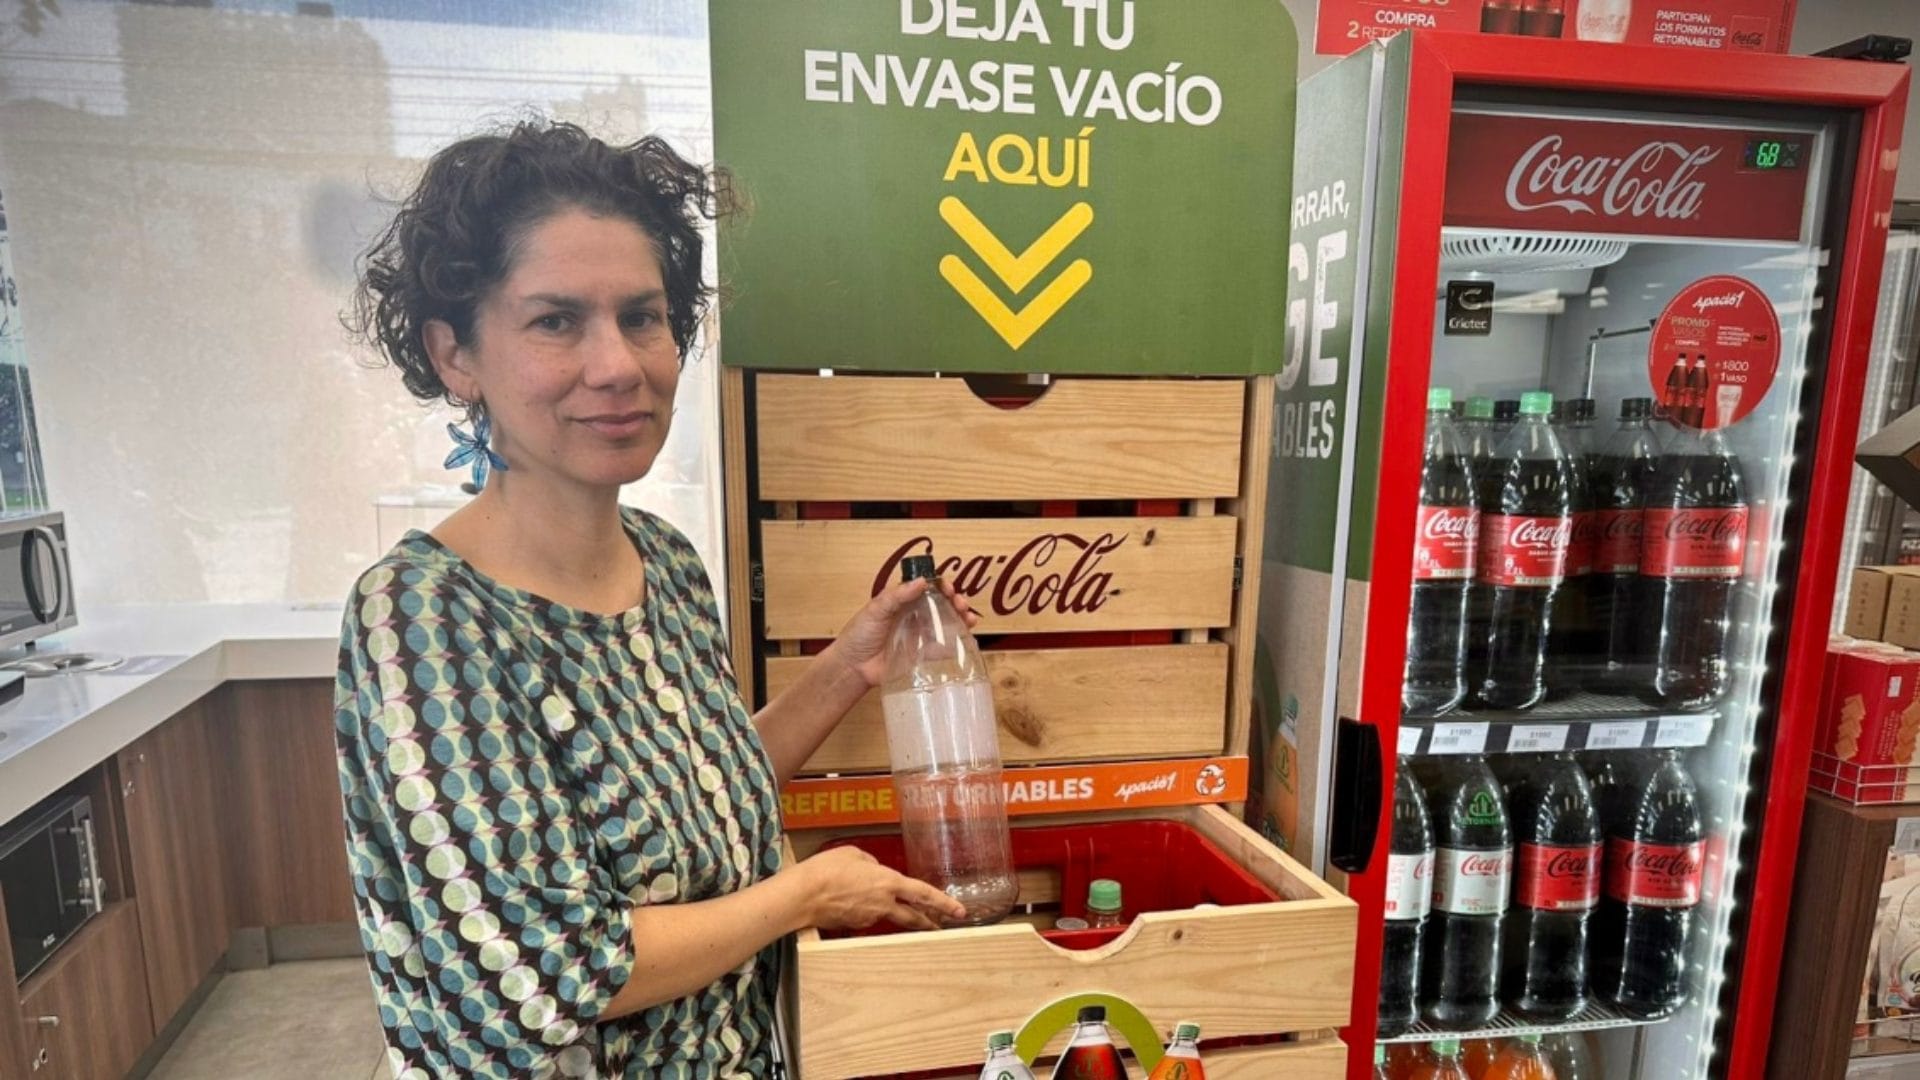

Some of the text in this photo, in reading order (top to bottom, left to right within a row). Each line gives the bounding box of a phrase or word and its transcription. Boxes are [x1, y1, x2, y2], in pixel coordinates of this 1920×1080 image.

[900, 0, 1050, 44] DEJA
[1347, 21, 1359, 38] 2
[1375, 10, 1436, 28] COMPRA
[1654, 22, 1727, 37] LOS FORMATOS
[1656, 10, 1711, 24] PARTICIPAN
[1653, 34, 1722, 48] RETORNABLES
[804, 49, 1223, 126] ENVASE VACÍO
[943, 127, 1096, 188] AQUÍ
[1505, 134, 1723, 220] Coca-Cola
[1291, 180, 1350, 230] RRAR,
[1671, 315, 1710, 328] PROMO
[871, 533, 1129, 617] Cca-Cola
